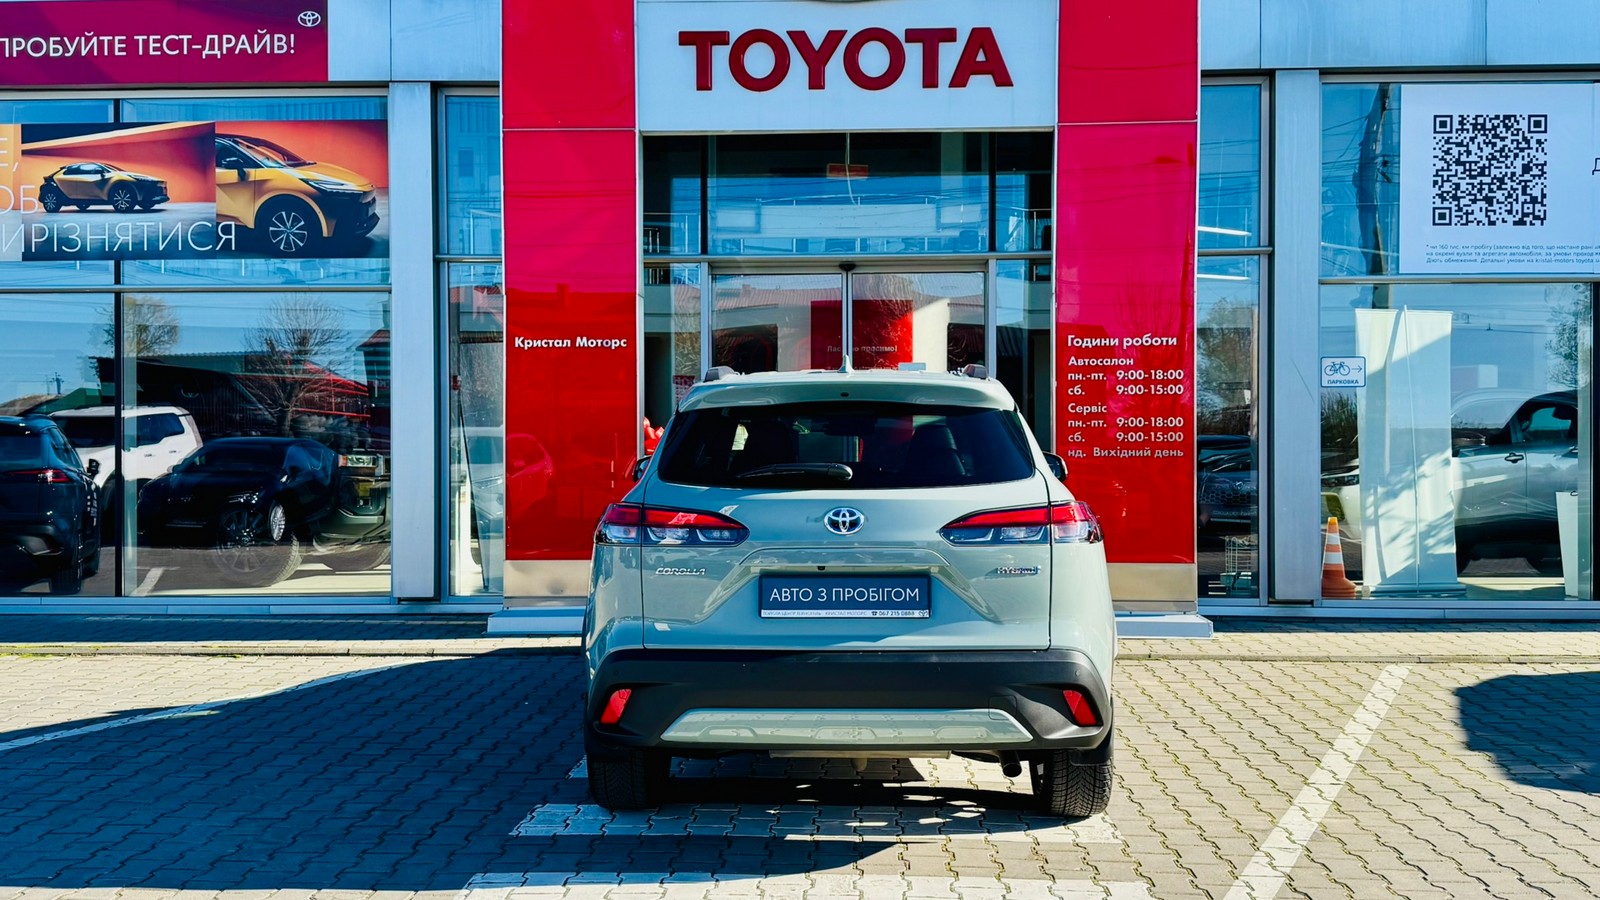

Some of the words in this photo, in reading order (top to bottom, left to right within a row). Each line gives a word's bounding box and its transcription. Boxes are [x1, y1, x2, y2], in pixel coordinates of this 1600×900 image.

[134, 29, 295, 59] ТЕСТ-ДРАЙВ!
[678, 27, 1014, 92] TOYOTA
[515, 337, 571, 350] Кристал
[576, 336, 627, 349] Моторс
[1067, 334, 1119, 349] Години
[1123, 333, 1177, 349] роботи
[1068, 356, 1134, 366] Автосалон
[1067, 372, 1107, 381] пн.-пт.
[1067, 384, 1086, 395] сб.
[1067, 402, 1107, 415] Сервіс
[1067, 419, 1107, 428] пн.-пт.
[1067, 431, 1086, 442] сб.
[1068, 450, 1087, 458] нд.
[1093, 447, 1151, 458] Вихідний
[1154, 450, 1184, 458] день
[655, 567, 706, 576] COROLLA
[770, 588, 813, 602] АВТО
[817, 588, 827, 602] З
[832, 588, 919, 602] ПРОБІГОМ
